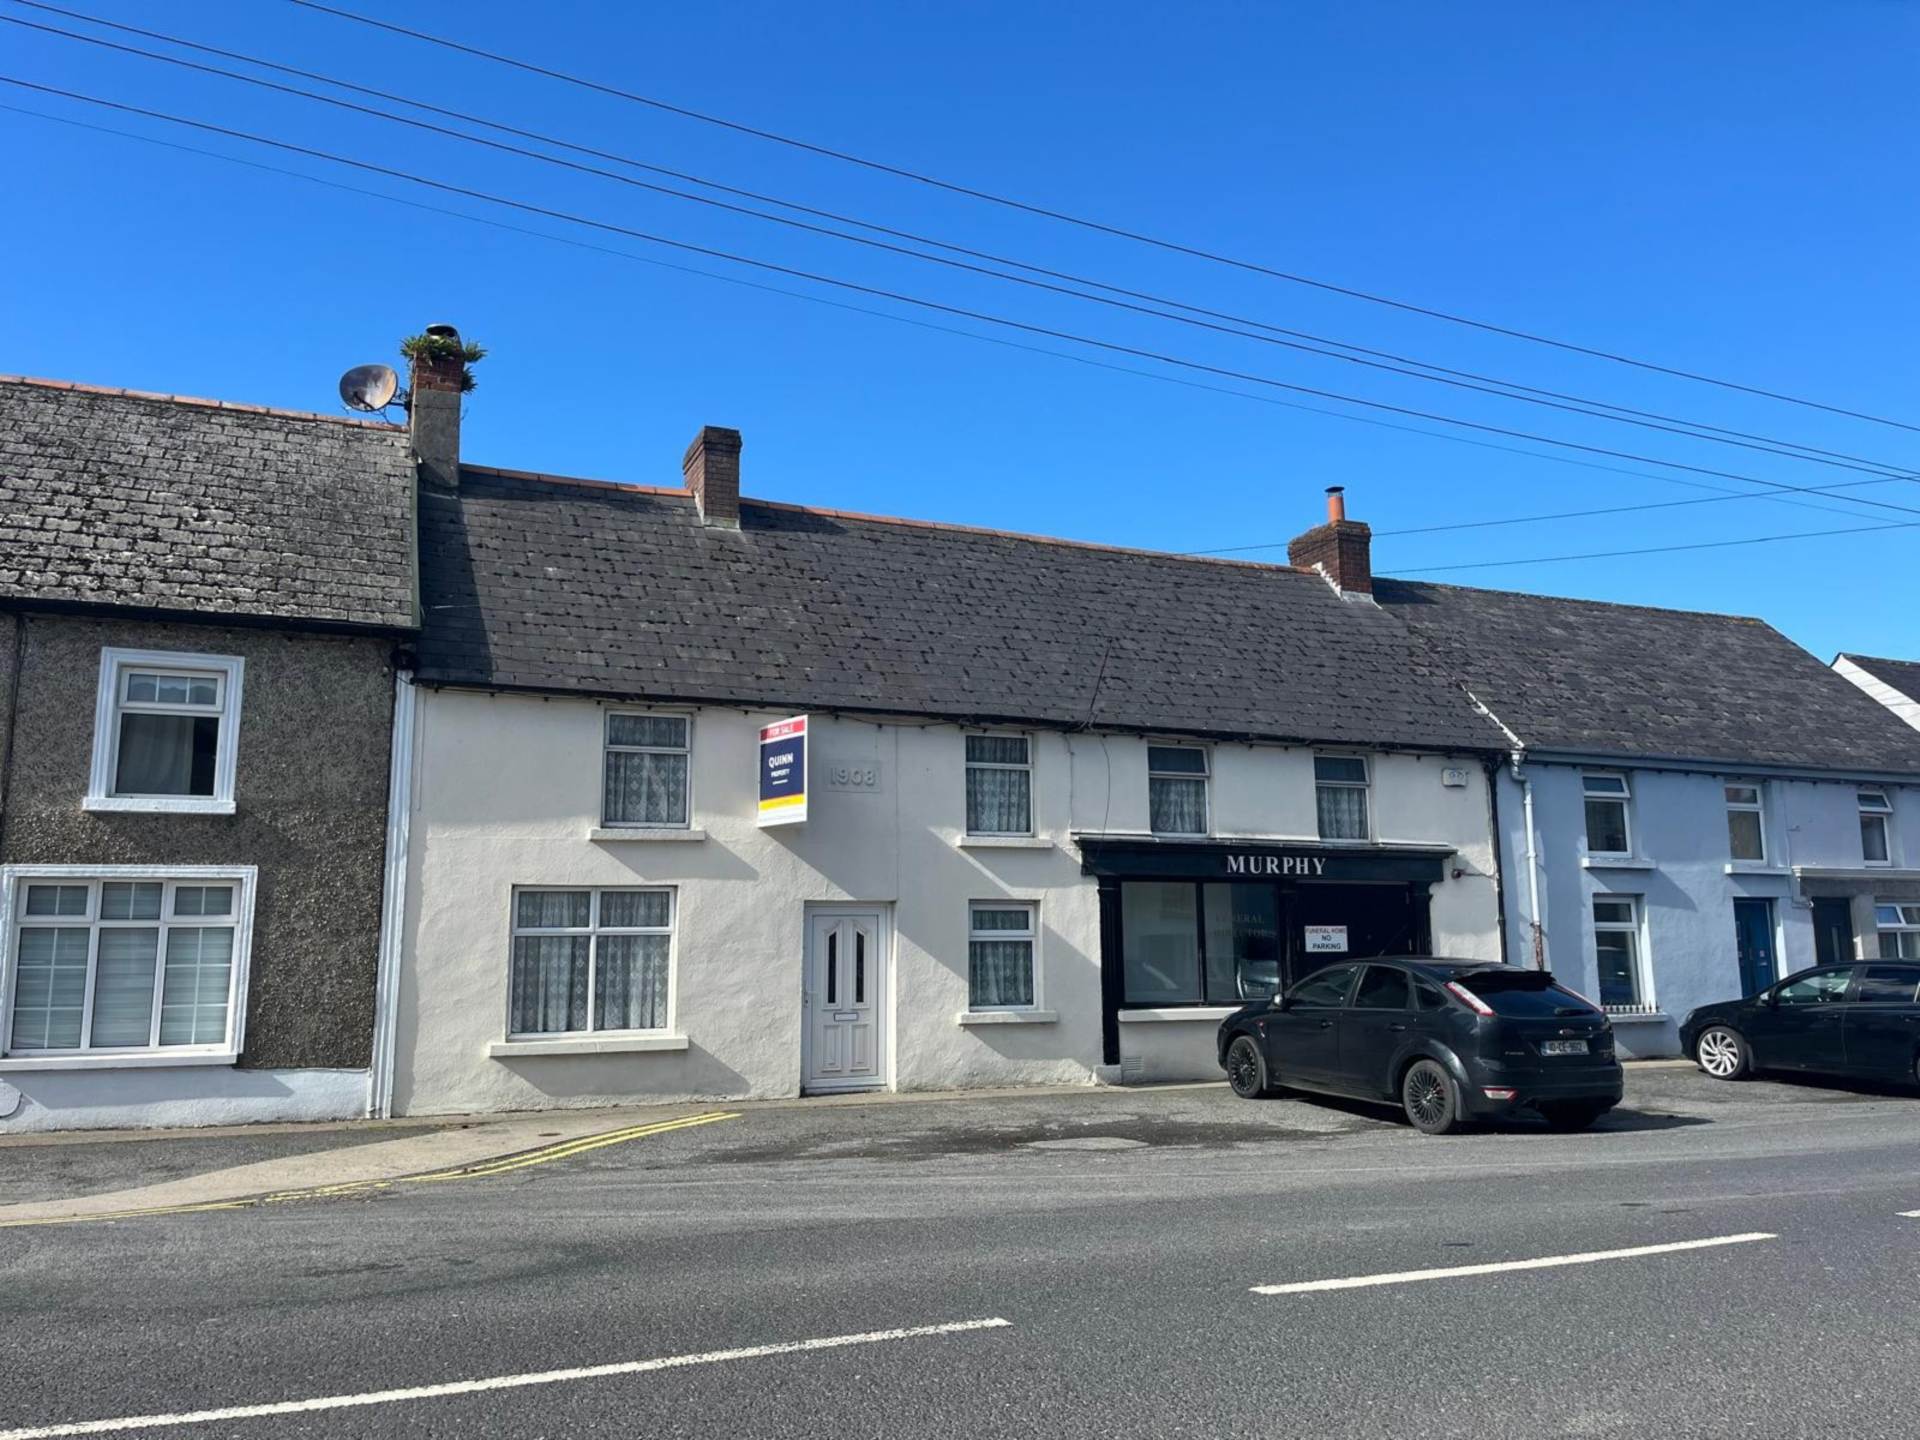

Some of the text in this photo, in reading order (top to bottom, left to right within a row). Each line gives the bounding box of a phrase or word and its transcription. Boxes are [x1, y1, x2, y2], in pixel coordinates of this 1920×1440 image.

[769, 723, 793, 737] FOR SALE
[768, 752, 794, 769] QUINN
[829, 767, 876, 787] 1908
[1226, 855, 1326, 875] MURPHY
[1321, 934, 1332, 942] NO
